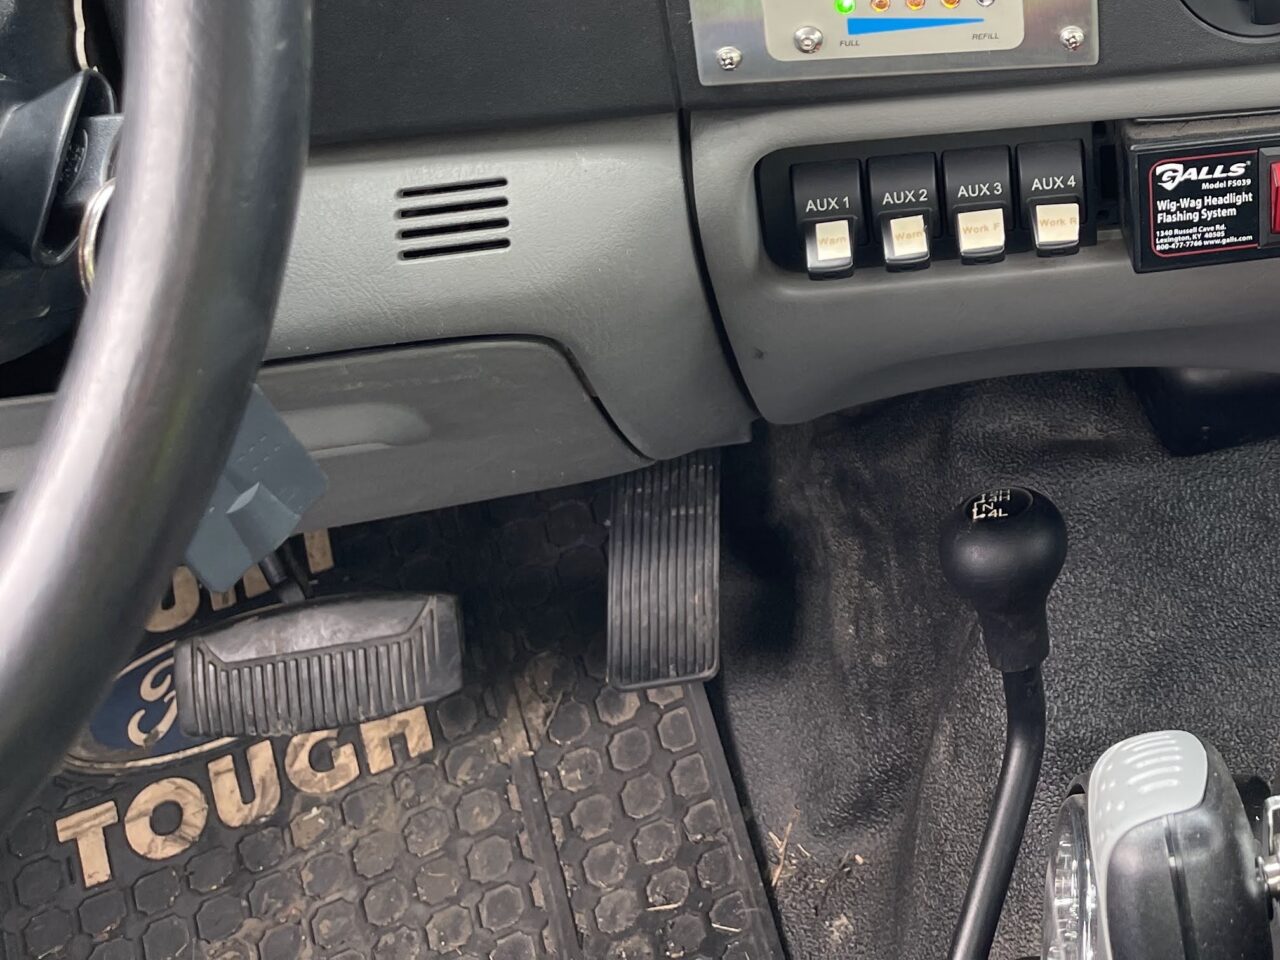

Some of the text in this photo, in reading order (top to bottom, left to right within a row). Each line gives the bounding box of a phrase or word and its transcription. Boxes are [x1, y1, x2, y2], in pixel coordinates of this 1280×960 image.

[971, 32, 1000, 41] REFILL
[839, 40, 861, 48] FULL
[1155, 162, 1248, 191] GALLS
[1032, 175, 1077, 191] AUX 4
[1201, 180, 1227, 190] Model
[957, 182, 1003, 199] AUX 3
[882, 189, 928, 206] AUX 2
[1156, 192, 1253, 212] Wig-Wag Headlight
[805, 198, 850, 212] AUX 1
[1157, 207, 1237, 224] Flashing System
[1039, 217, 1067, 228] Work
[962, 224, 990, 235] Work
[1173, 226, 1197, 235] Russell
[982, 501, 994, 512] N
[988, 507, 1008, 518] 4L
